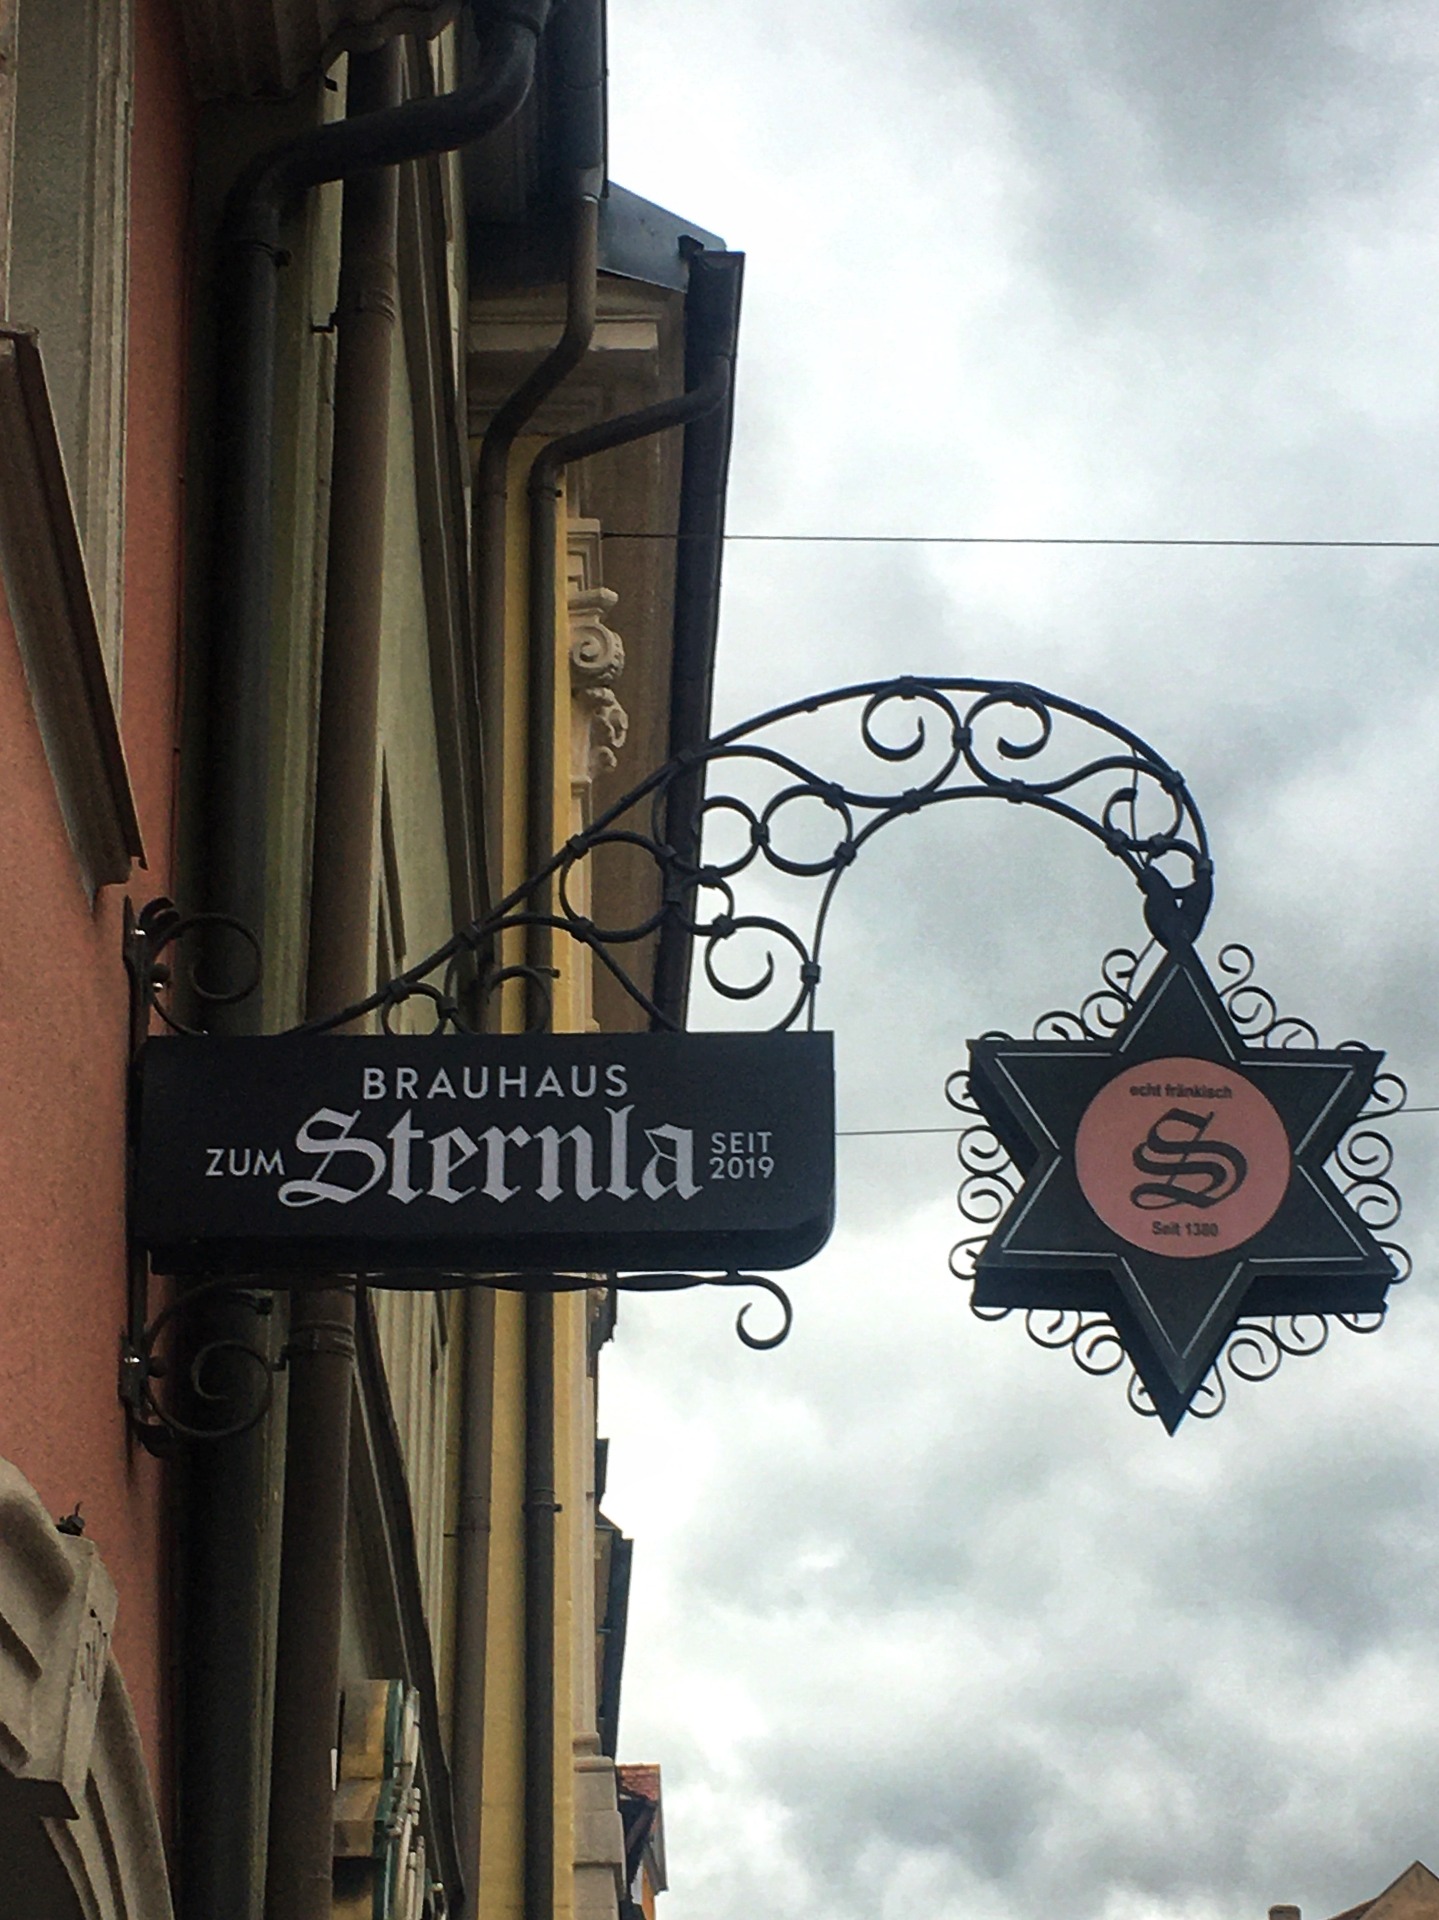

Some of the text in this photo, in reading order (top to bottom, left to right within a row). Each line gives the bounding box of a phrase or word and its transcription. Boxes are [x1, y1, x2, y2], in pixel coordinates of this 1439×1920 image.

[362, 1064, 629, 1100] BRAUHAUS
[1129, 1083, 1162, 1097] echt
[711, 1131, 773, 1154] SEIT
[205, 1104, 703, 1207] ZUM Sternla
[710, 1156, 775, 1180] 2019
[1152, 1220, 1180, 1236] Seit
